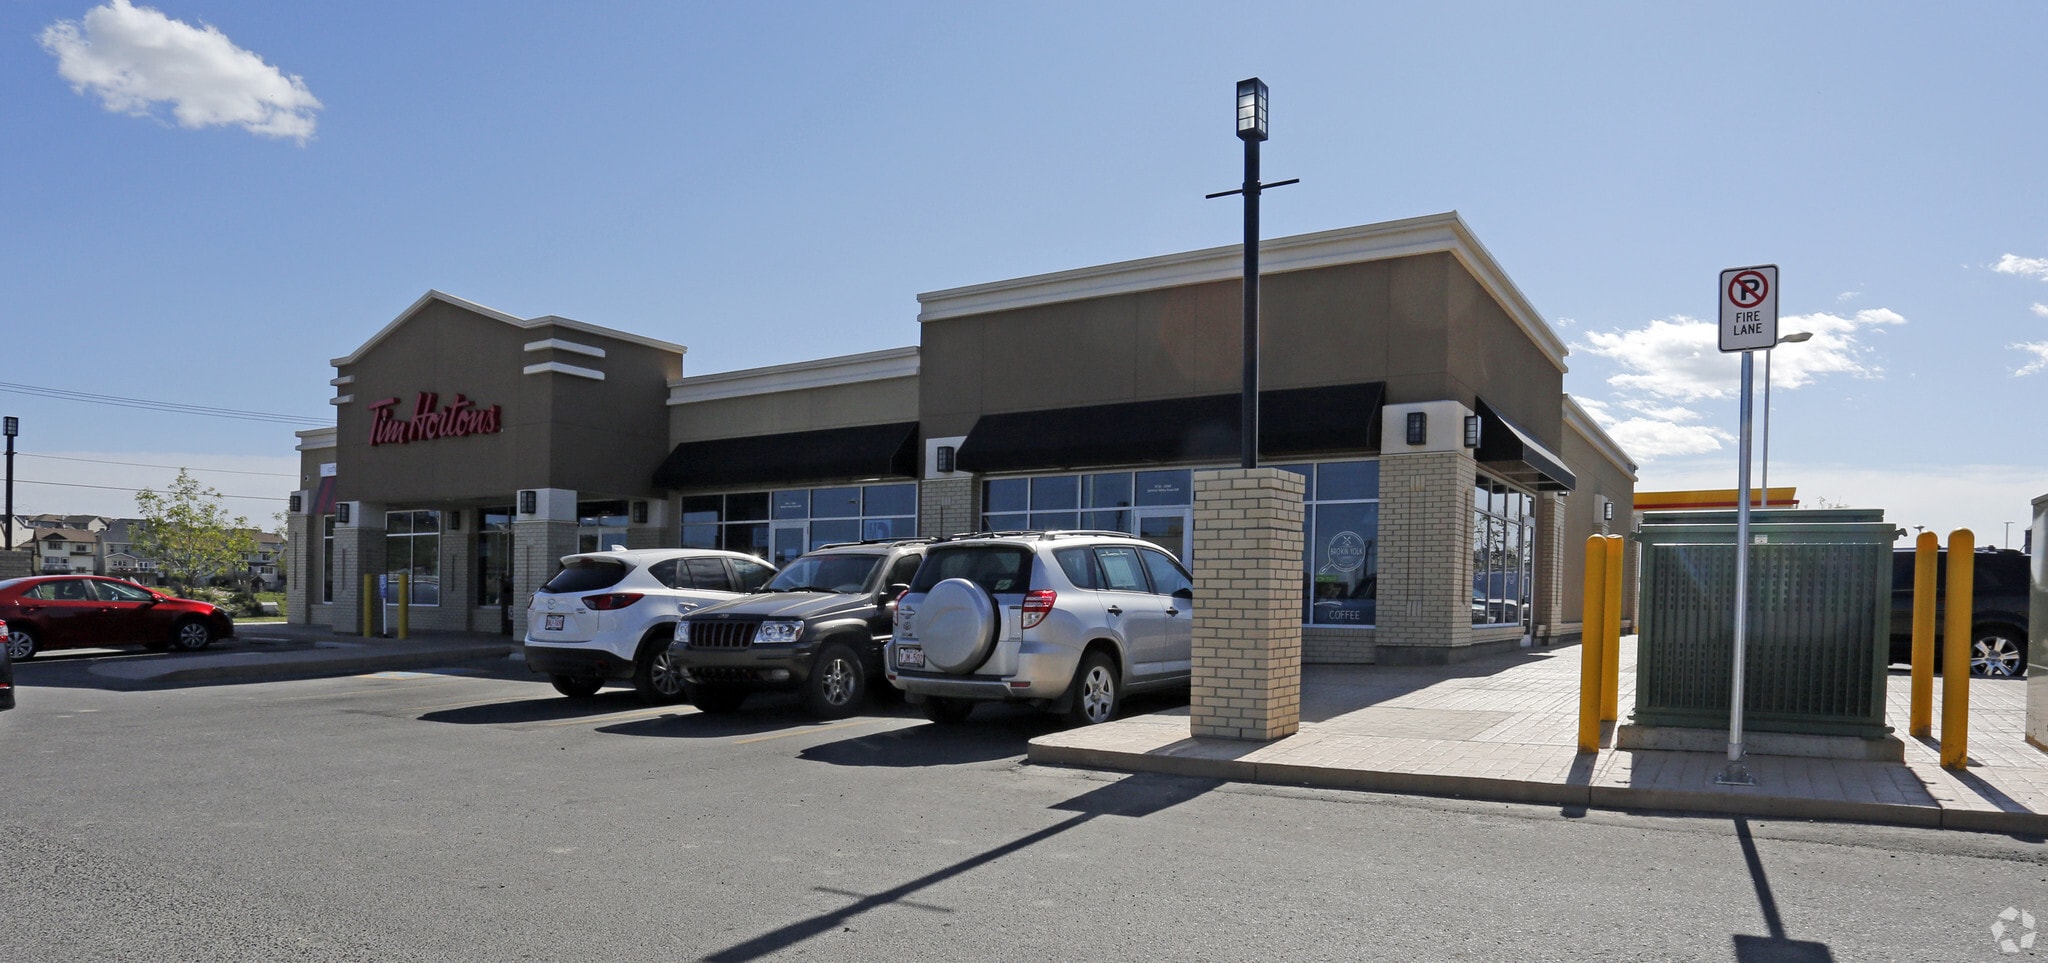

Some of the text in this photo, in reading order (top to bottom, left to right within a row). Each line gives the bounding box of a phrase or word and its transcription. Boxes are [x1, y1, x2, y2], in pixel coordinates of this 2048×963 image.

[1736, 311, 1760, 323] FIRE
[1733, 323, 1762, 336] LANE
[368, 391, 501, 447] Tim Hortons
[1350, 547, 1363, 556] YOLK
[1329, 610, 1360, 620] COFFEE
